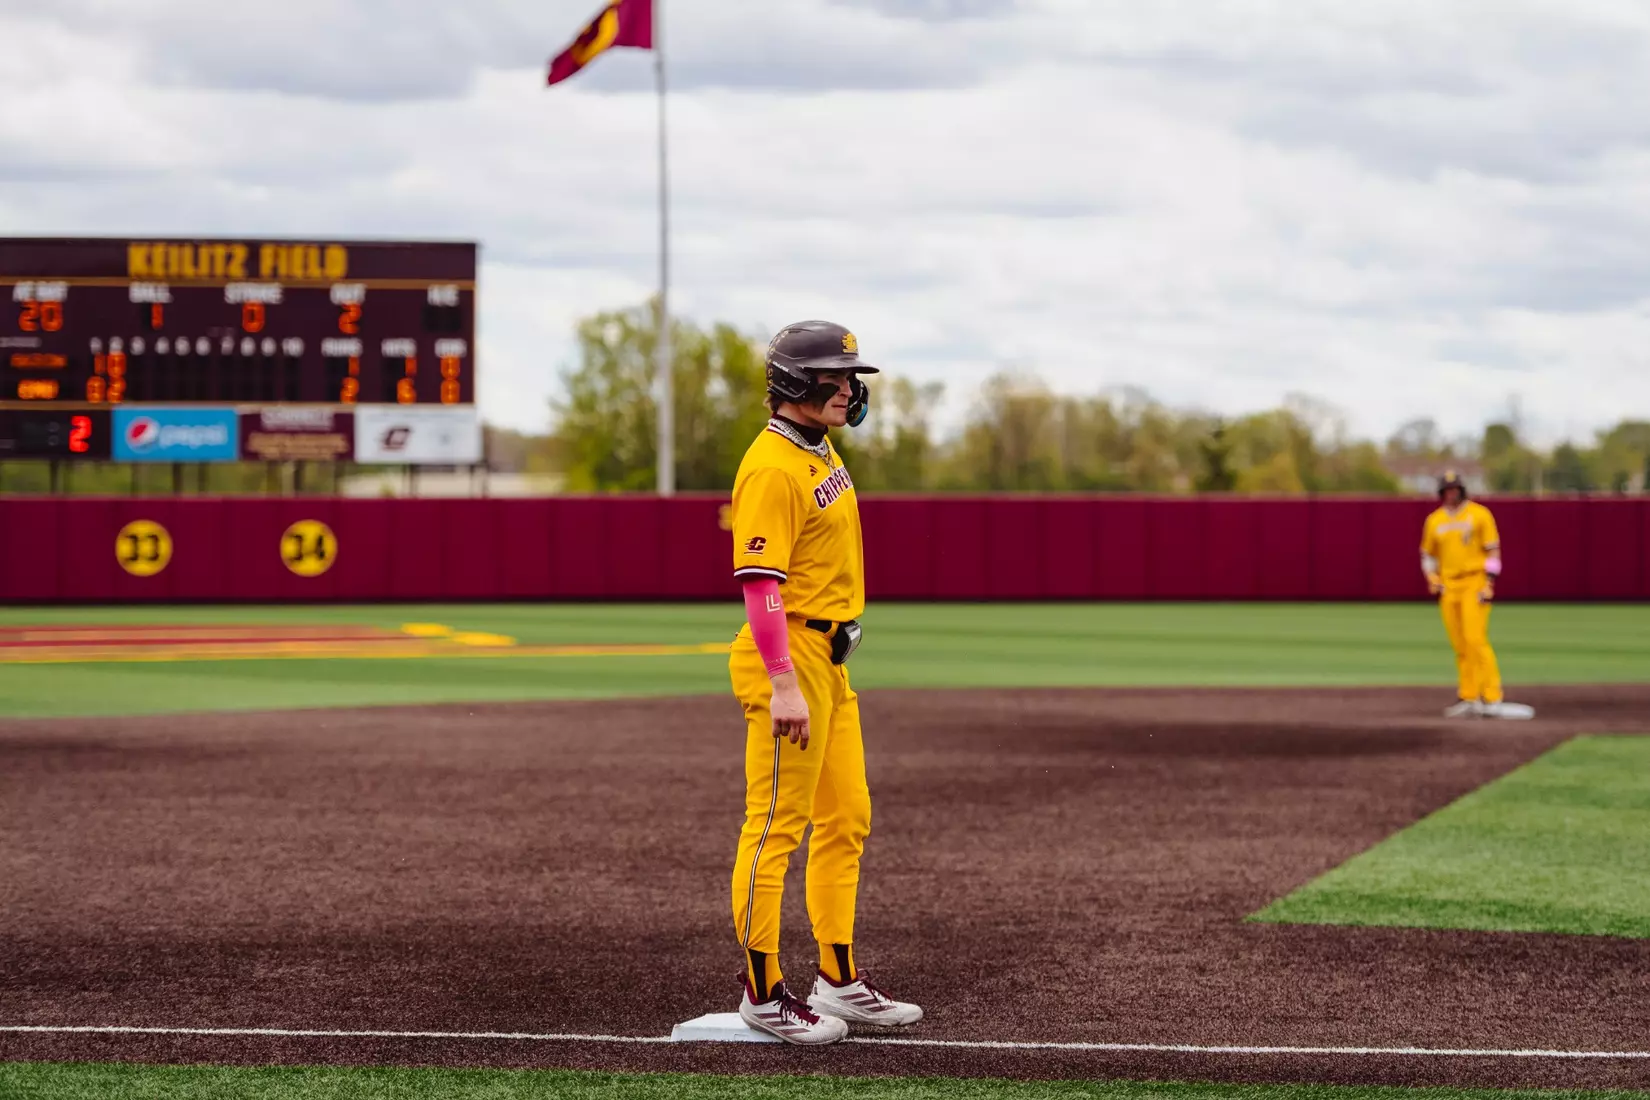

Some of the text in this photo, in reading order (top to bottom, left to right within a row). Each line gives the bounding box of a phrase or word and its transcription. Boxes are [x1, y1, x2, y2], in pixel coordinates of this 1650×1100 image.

[127, 243, 348, 279] KEILITZ FIELD
[18, 299, 63, 331] 20
[151, 303, 163, 329] 1
[242, 302, 265, 332] 0
[338, 303, 362, 334] 2
[69, 415, 91, 452] 2
[288, 533, 327, 562] 34
